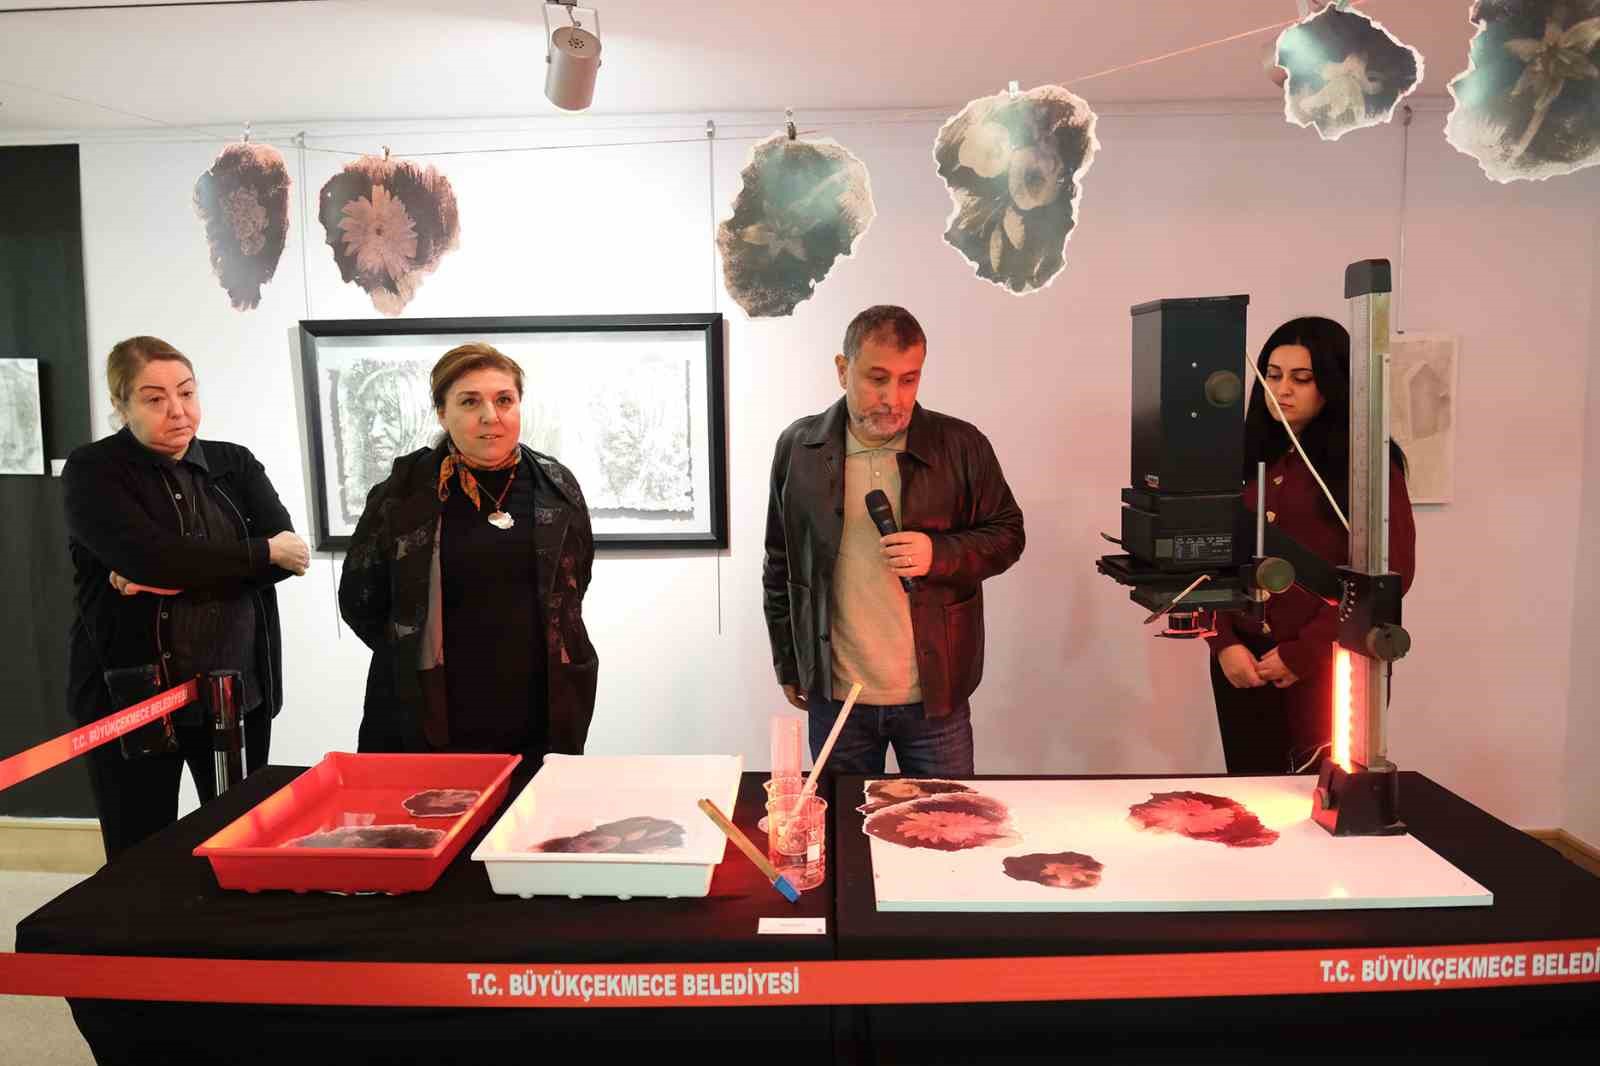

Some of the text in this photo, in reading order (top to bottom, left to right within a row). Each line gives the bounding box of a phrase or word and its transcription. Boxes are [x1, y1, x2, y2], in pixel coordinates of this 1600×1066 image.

[467, 966, 800, 1002] T.C. BÜYÜKÇEKMECE BELEDİYESİ
[1320, 959, 1355, 982] T.C.
[1361, 954, 1527, 985] BÜYÜKÇEKMECE
